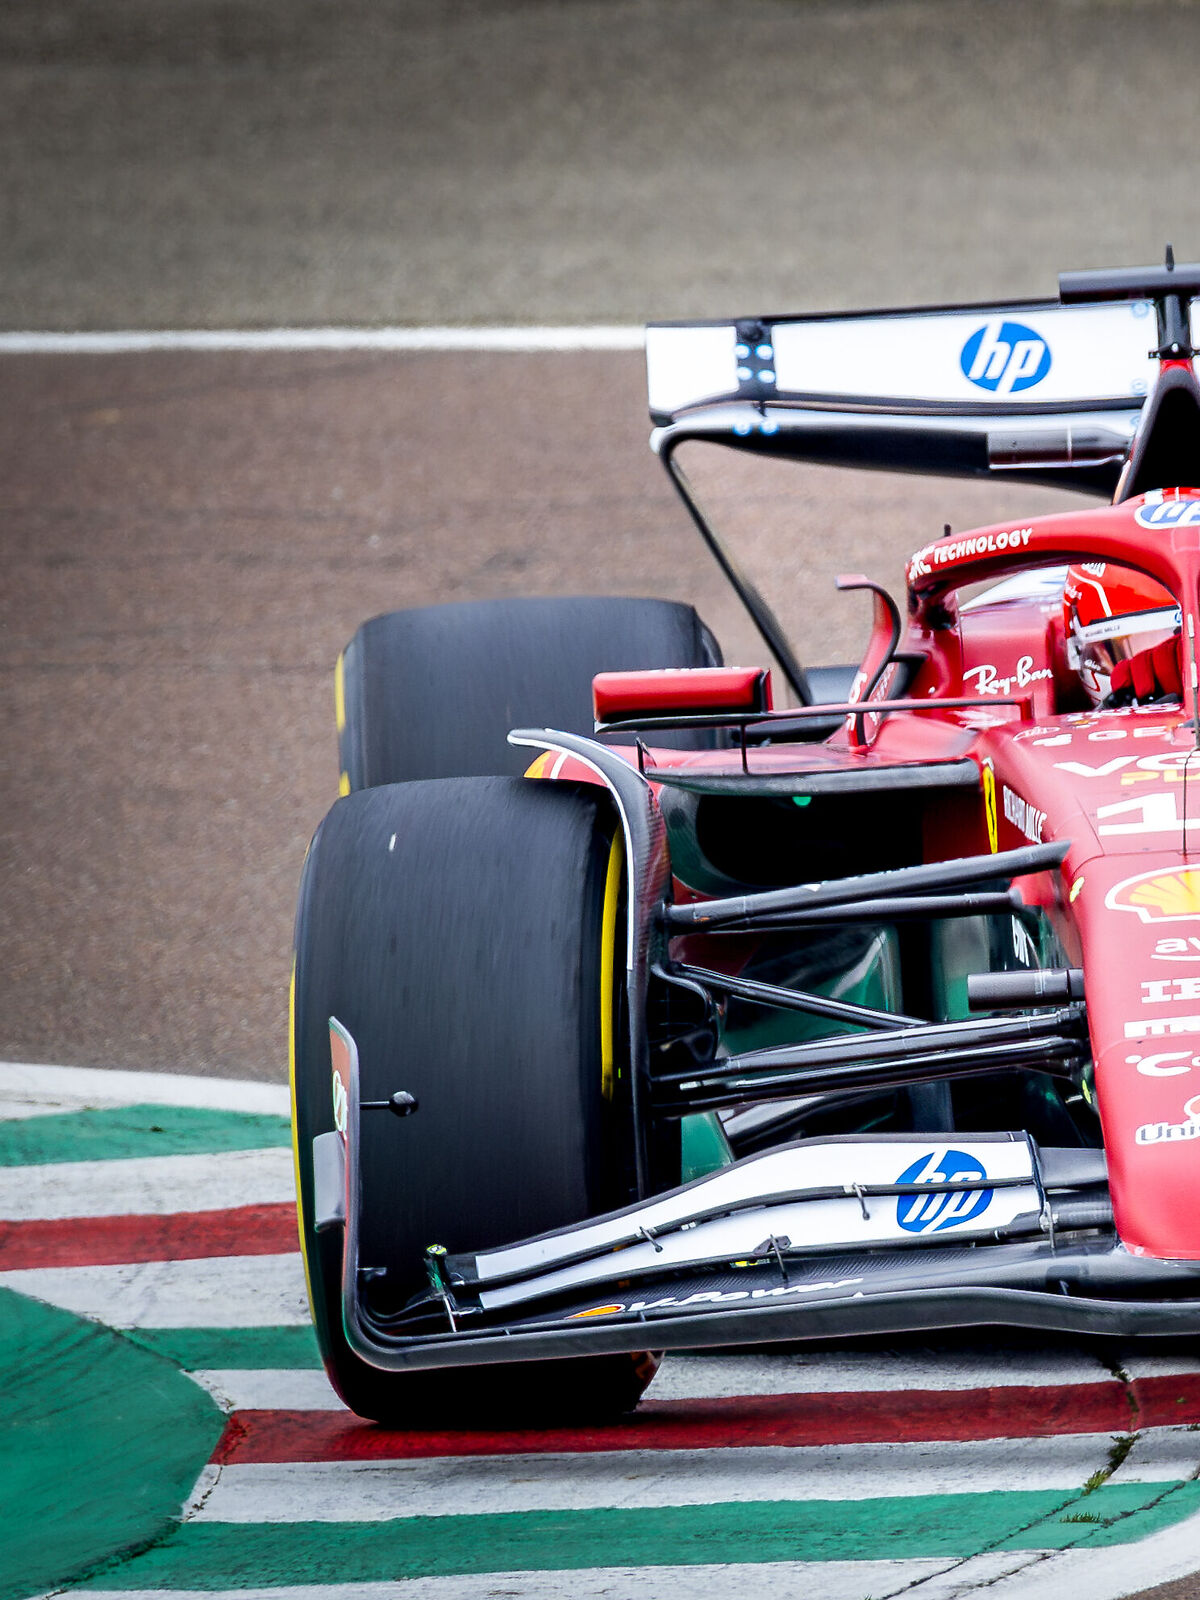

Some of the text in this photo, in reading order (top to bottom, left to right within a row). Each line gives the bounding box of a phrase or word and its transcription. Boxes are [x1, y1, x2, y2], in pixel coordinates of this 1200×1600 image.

[963, 321, 1050, 392] hp
[934, 528, 1032, 564] TECHNOLOGY
[962, 655, 1054, 696] Ray-Ban
[899, 1149, 990, 1233] hp
